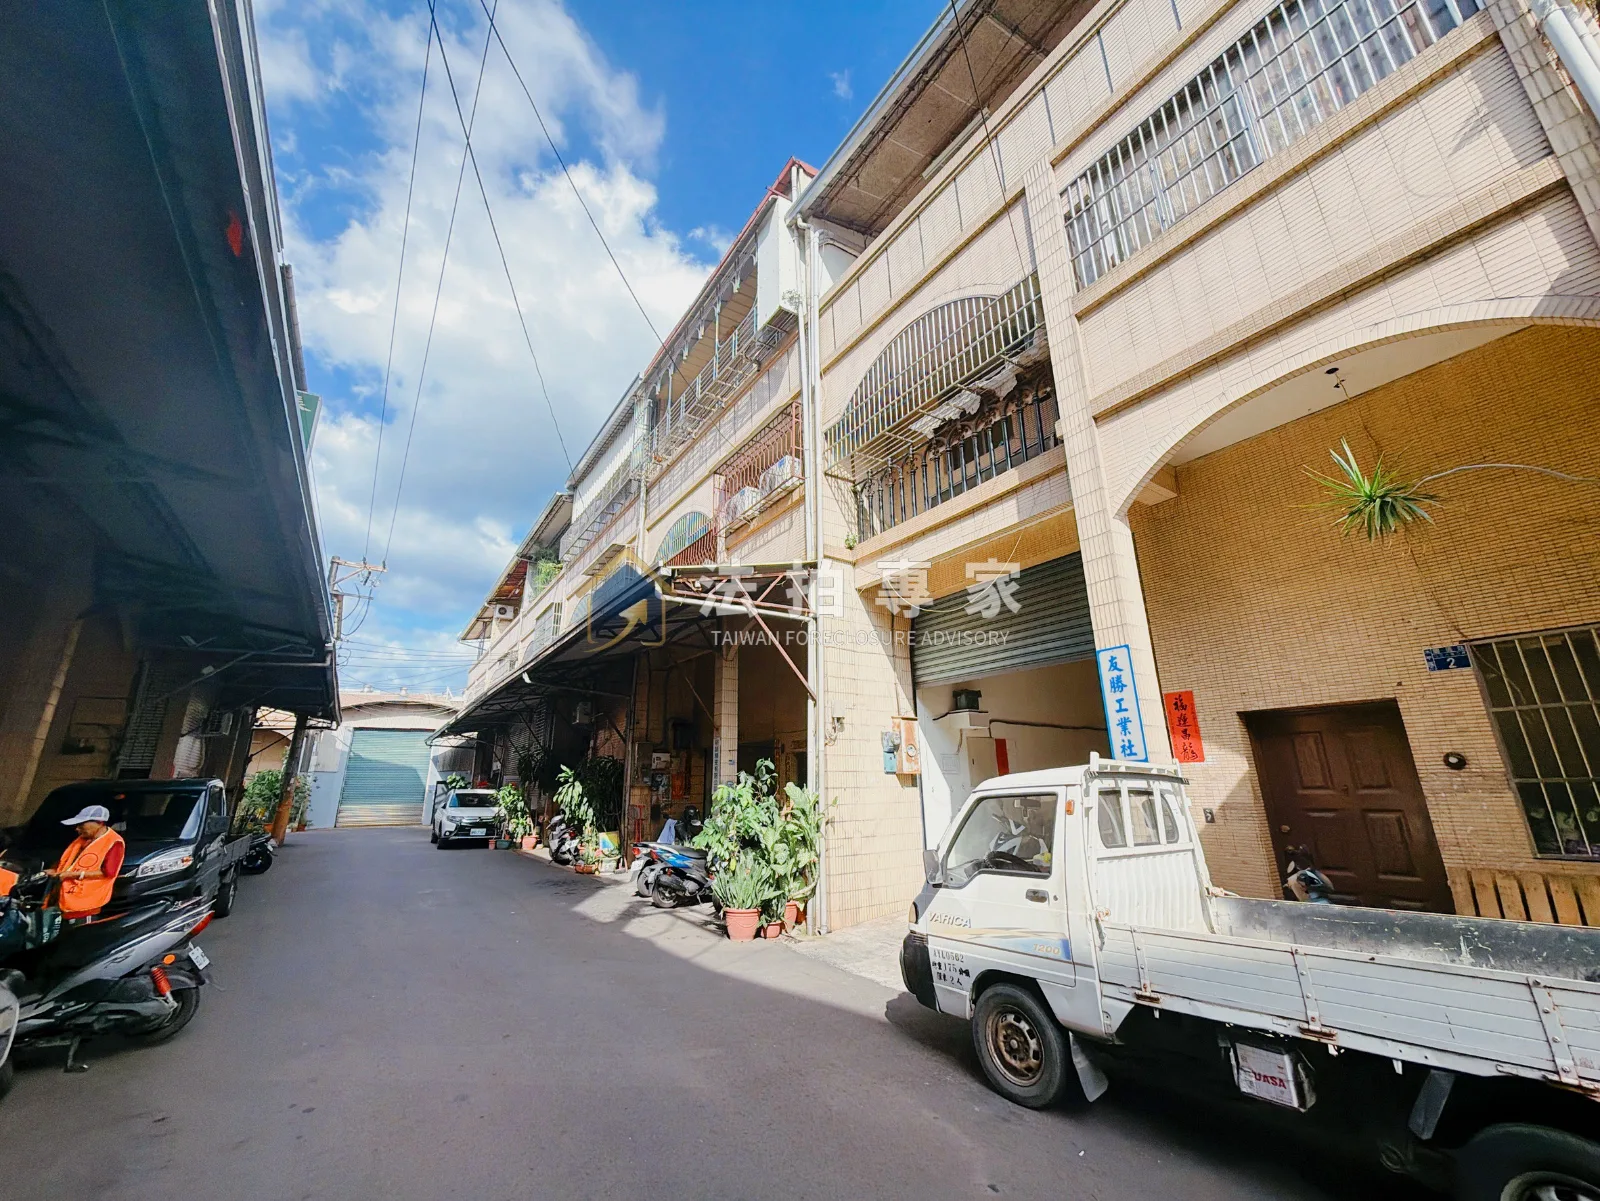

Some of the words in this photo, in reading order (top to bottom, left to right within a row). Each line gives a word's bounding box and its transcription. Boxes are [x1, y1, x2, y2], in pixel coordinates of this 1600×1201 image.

[1446, 657, 1457, 669] 2
[1108, 655, 1137, 757] 友勝工業社
[930, 912, 972, 928] VARICA
[1033, 943, 1060, 955] 1200
